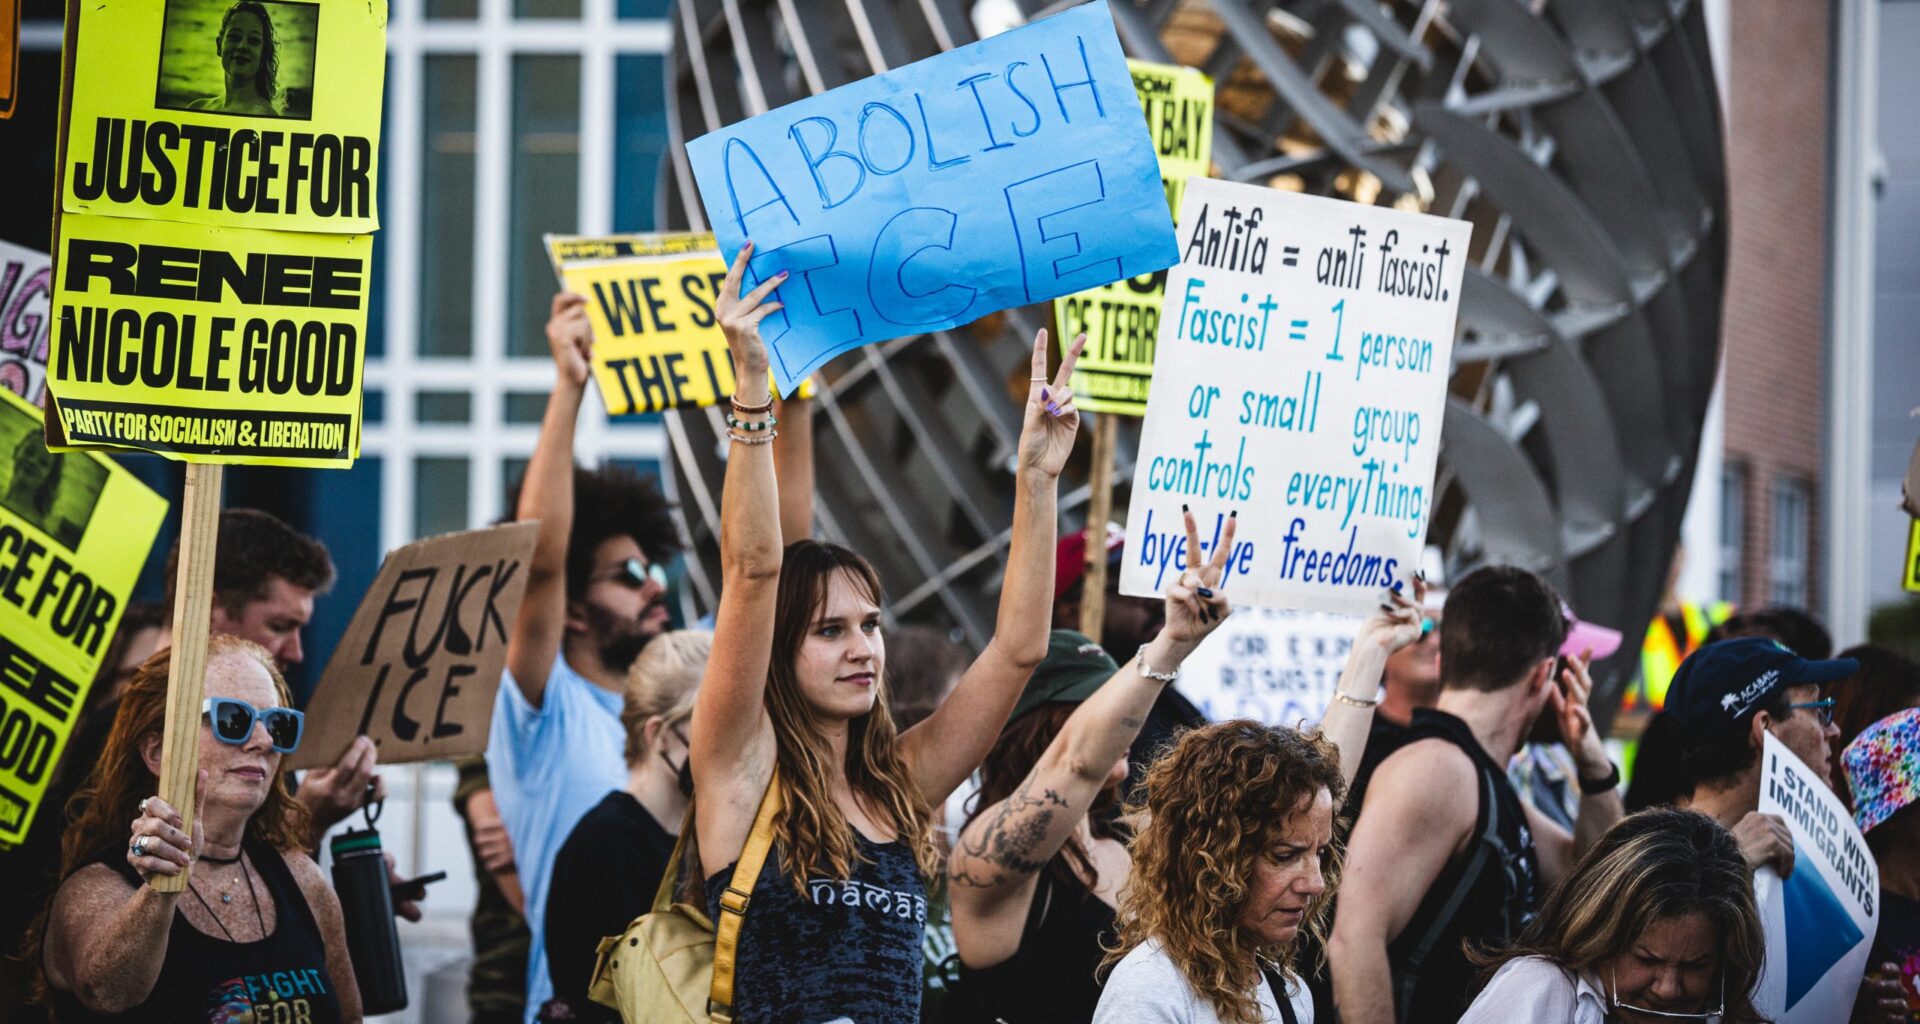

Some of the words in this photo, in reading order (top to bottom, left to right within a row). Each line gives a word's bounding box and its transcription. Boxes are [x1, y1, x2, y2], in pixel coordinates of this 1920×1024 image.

[73, 117, 283, 213] JUSTICE
[285, 133, 371, 218] FOR
[722, 36, 1107, 238] ABOLISH
[1160, 99, 1206, 160] BAY
[64, 239, 363, 310] RENEE
[747, 159, 1123, 384] ICE
[1183, 203, 1268, 276] Antifa
[1316, 224, 1366, 291] anti
[1377, 229, 1450, 302] fascist.
[56, 305, 235, 392] NICOLE
[239, 318, 357, 397] GOOD
[592, 278, 676, 337] WE
[1100, 301, 1160, 364] TERR
[1177, 278, 1278, 352] Fascist
[1325, 298, 1345, 362] 1
[1356, 329, 1432, 381] person
[63, 407, 113, 438] PARTY
[115, 412, 147, 441] FOR
[149, 415, 236, 445] SOCIALISM
[237, 420, 257, 446] &
[260, 420, 345, 451] LIBERATION
[606, 353, 698, 413] THE
[1188, 384, 1220, 419] or
[1239, 370, 1321, 433] small
[1352, 404, 1420, 462] group
[1148, 429, 1255, 501] controls
[1279, 518, 1403, 592] freedoms.
[27, 555, 117, 658] FOR
[360, 558, 520, 669] FUCK
[1769, 778, 1873, 918] IMMIGRANTS
[1771, 753, 1777, 775] I
[1784, 766, 1839, 836] STAND
[1843, 828, 1875, 893] WITH
[244, 968, 327, 1002] FIGHT
[254, 998, 312, 1024] FOR
